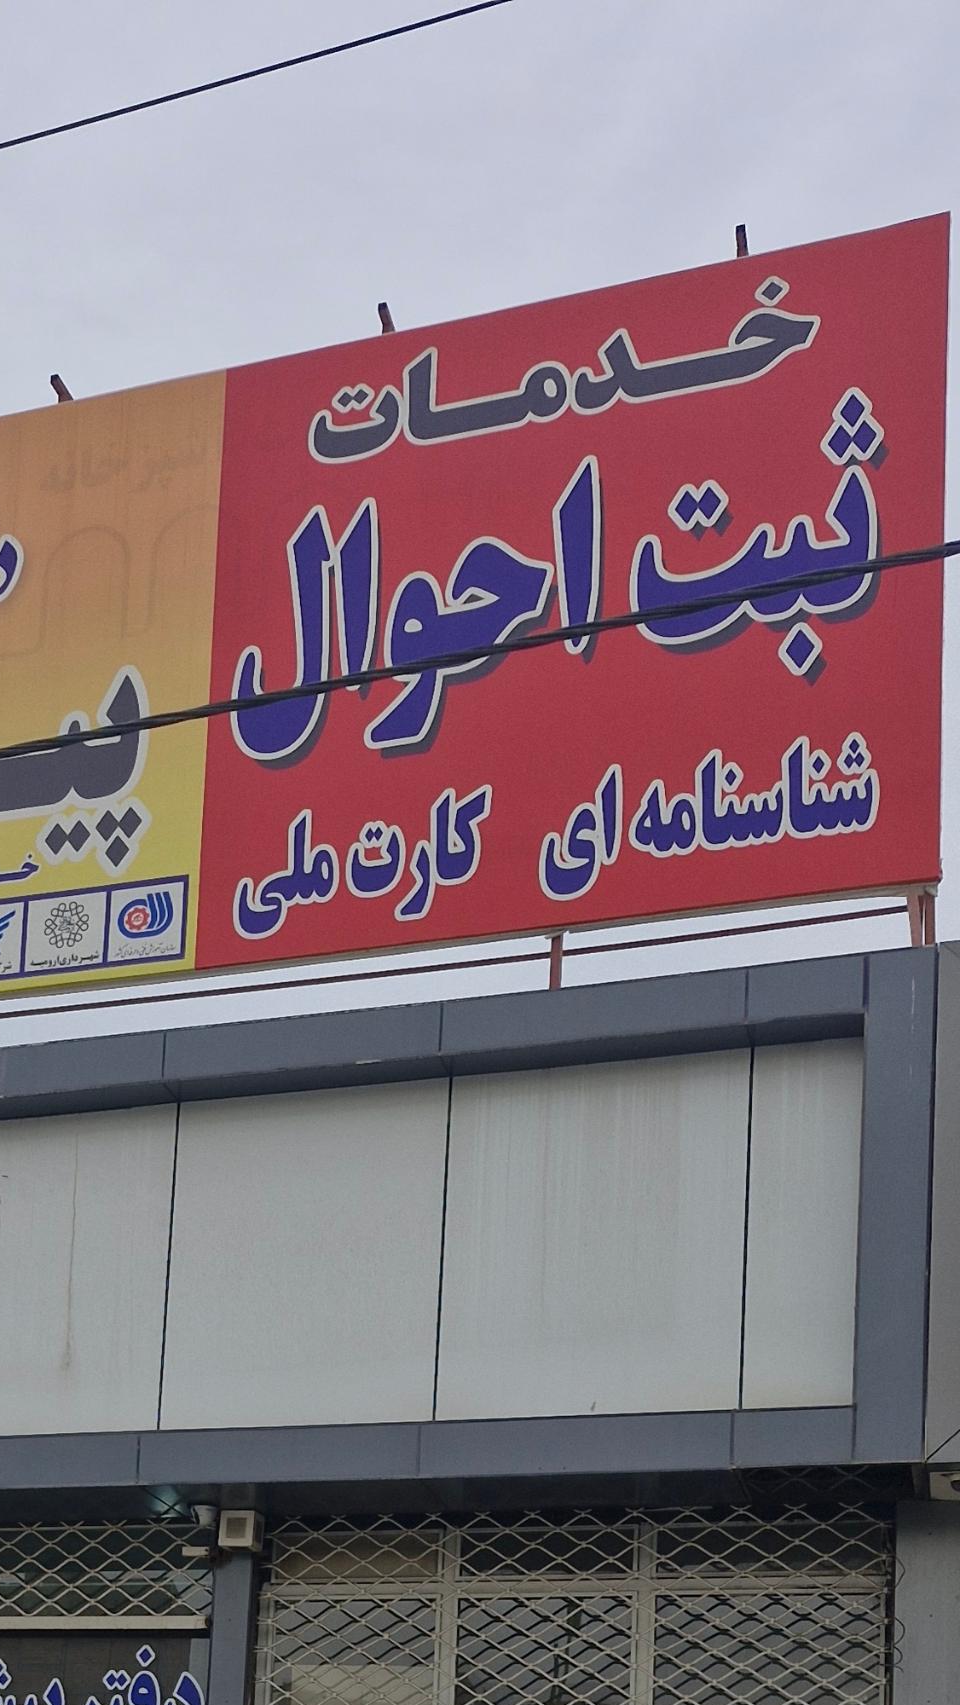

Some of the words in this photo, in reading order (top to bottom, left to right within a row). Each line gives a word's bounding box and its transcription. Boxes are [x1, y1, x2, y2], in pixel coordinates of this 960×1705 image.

[307, 276, 821, 464] خدمات
[629, 387, 885, 677] ثبت
[230, 455, 602, 760] احوال
[345, 784, 493, 921] کارت
[539, 763, 623, 900] ای
[628, 731, 880, 858] شناسنامه
[233, 808, 339, 939] ملی
